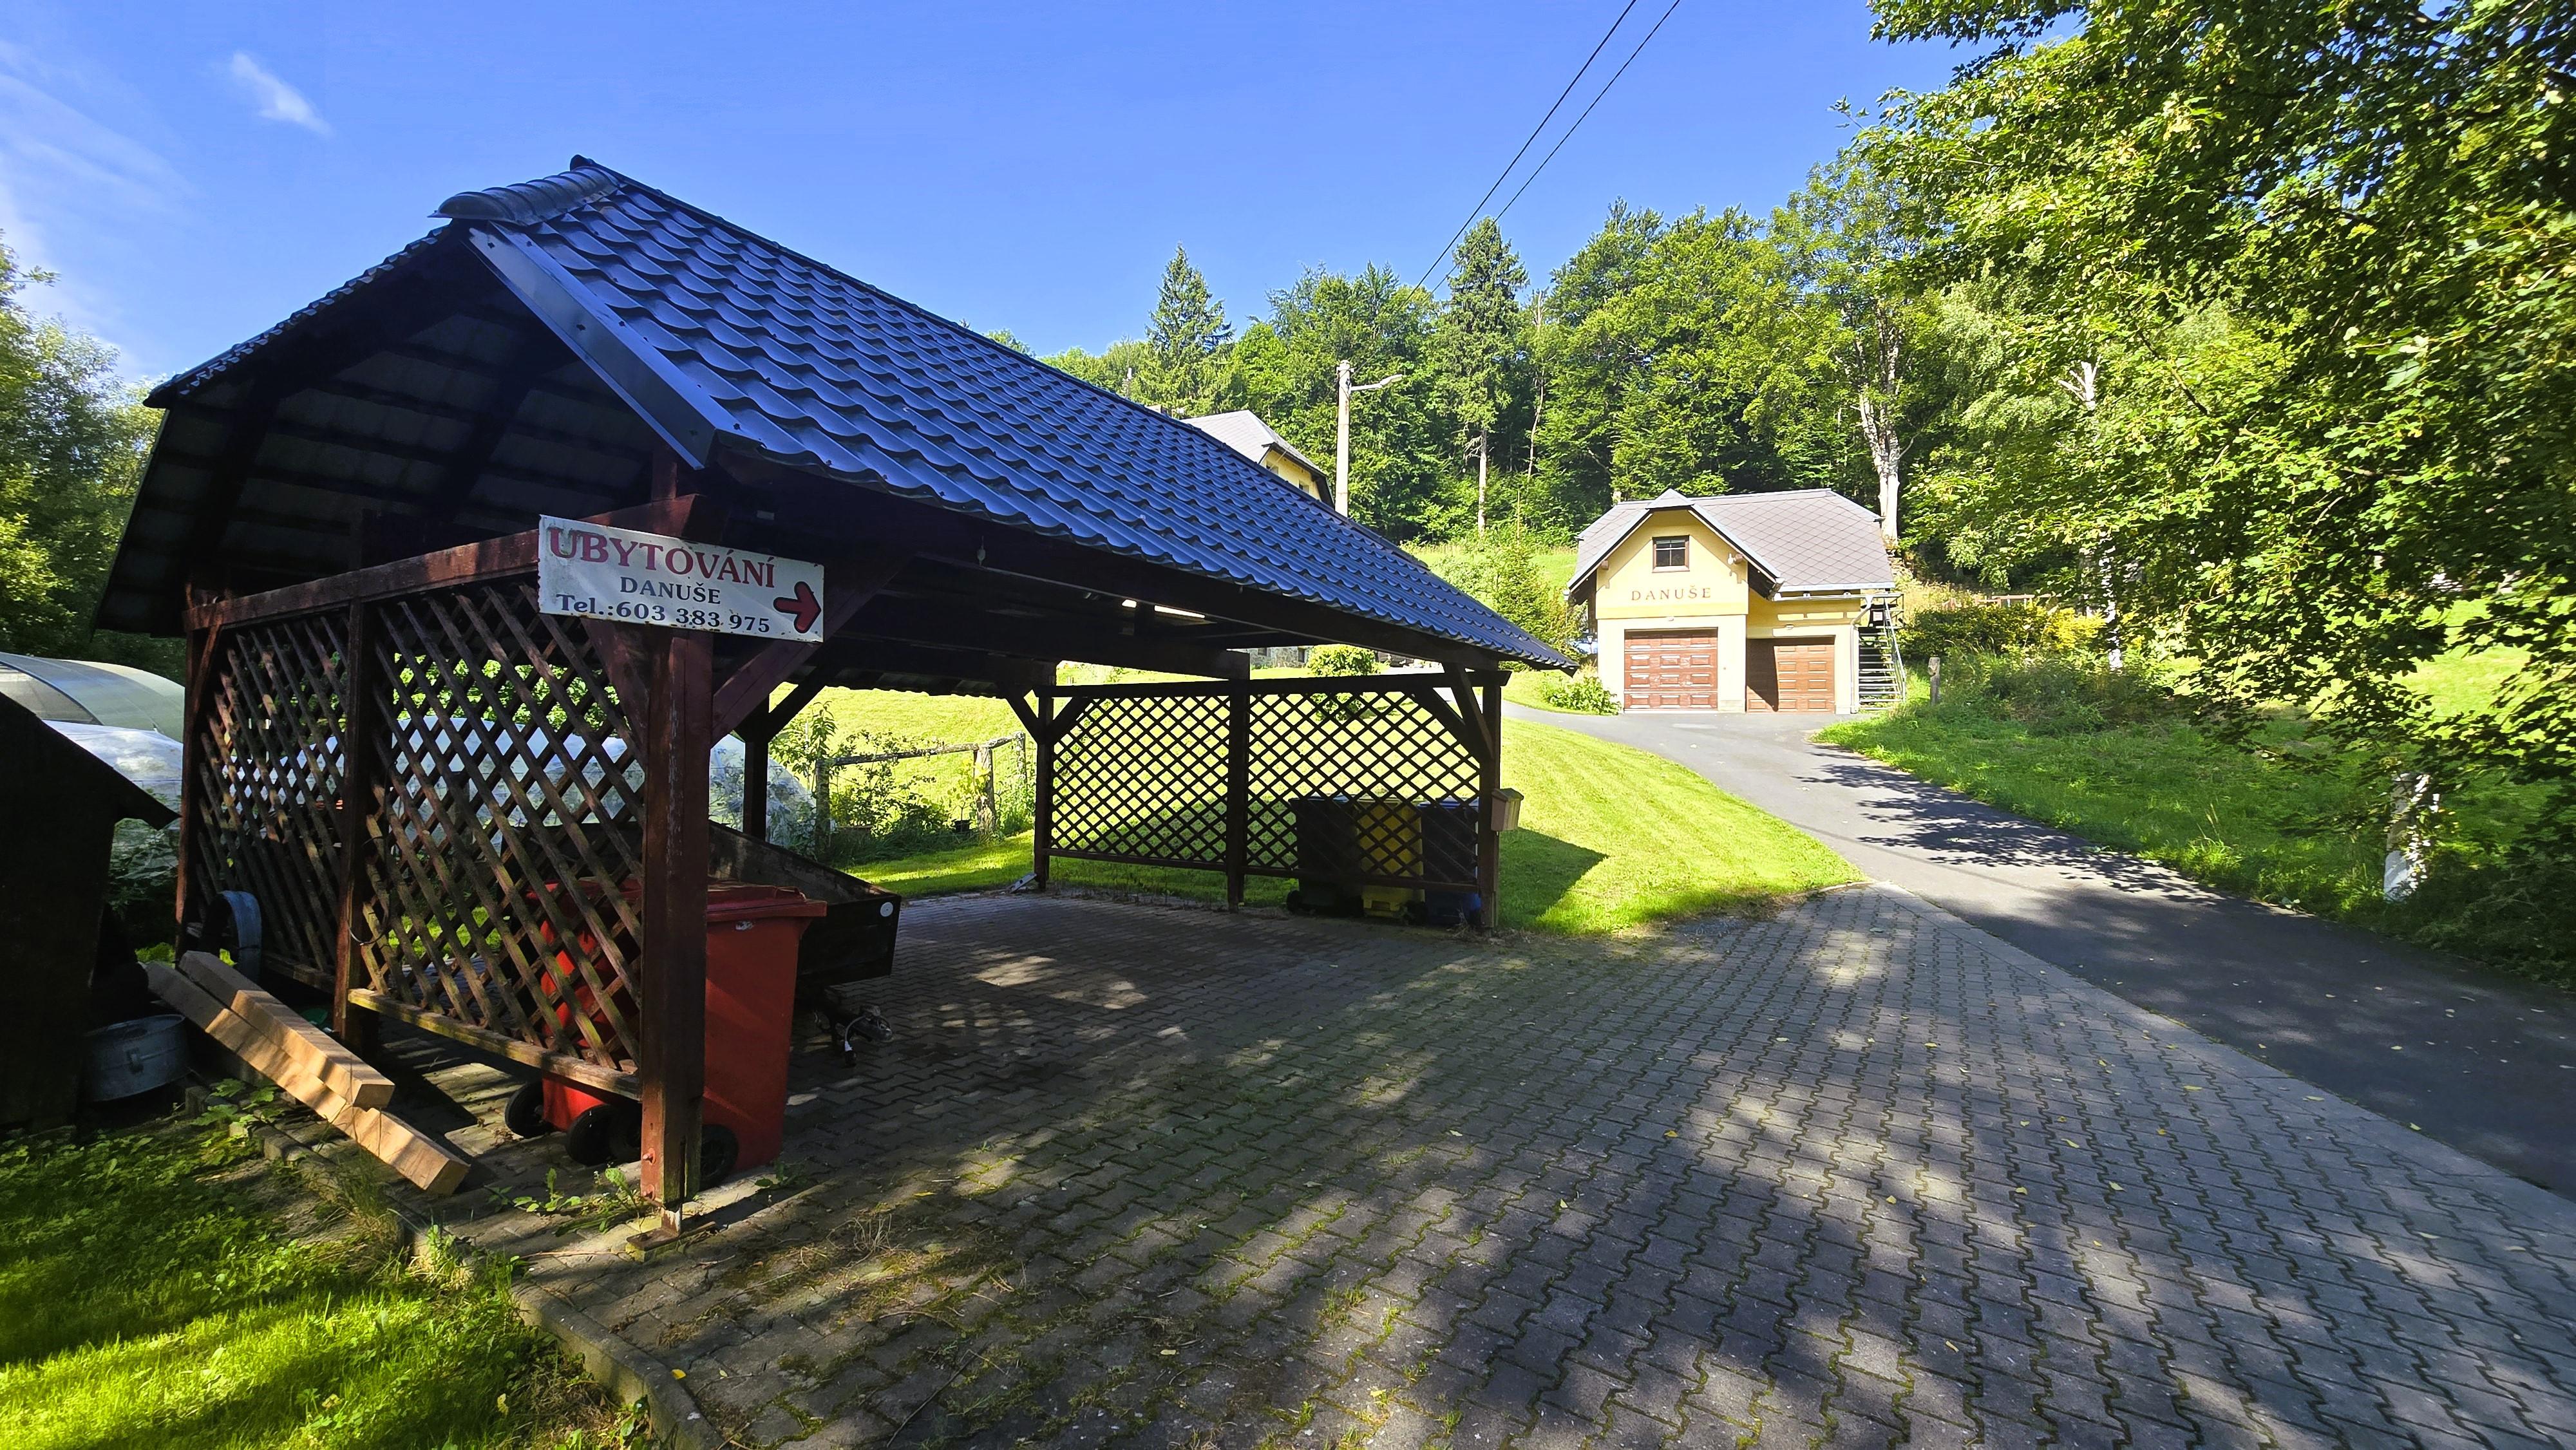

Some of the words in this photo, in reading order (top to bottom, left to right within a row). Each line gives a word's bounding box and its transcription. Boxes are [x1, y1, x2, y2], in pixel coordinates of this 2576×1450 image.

[550, 528, 775, 588] UBYTOVÁNÍ
[620, 576, 721, 605] DANUŠE
[1631, 585, 1710, 601] DANUŠE
[676, 607, 720, 628] 383
[729, 614, 770, 633] 975
